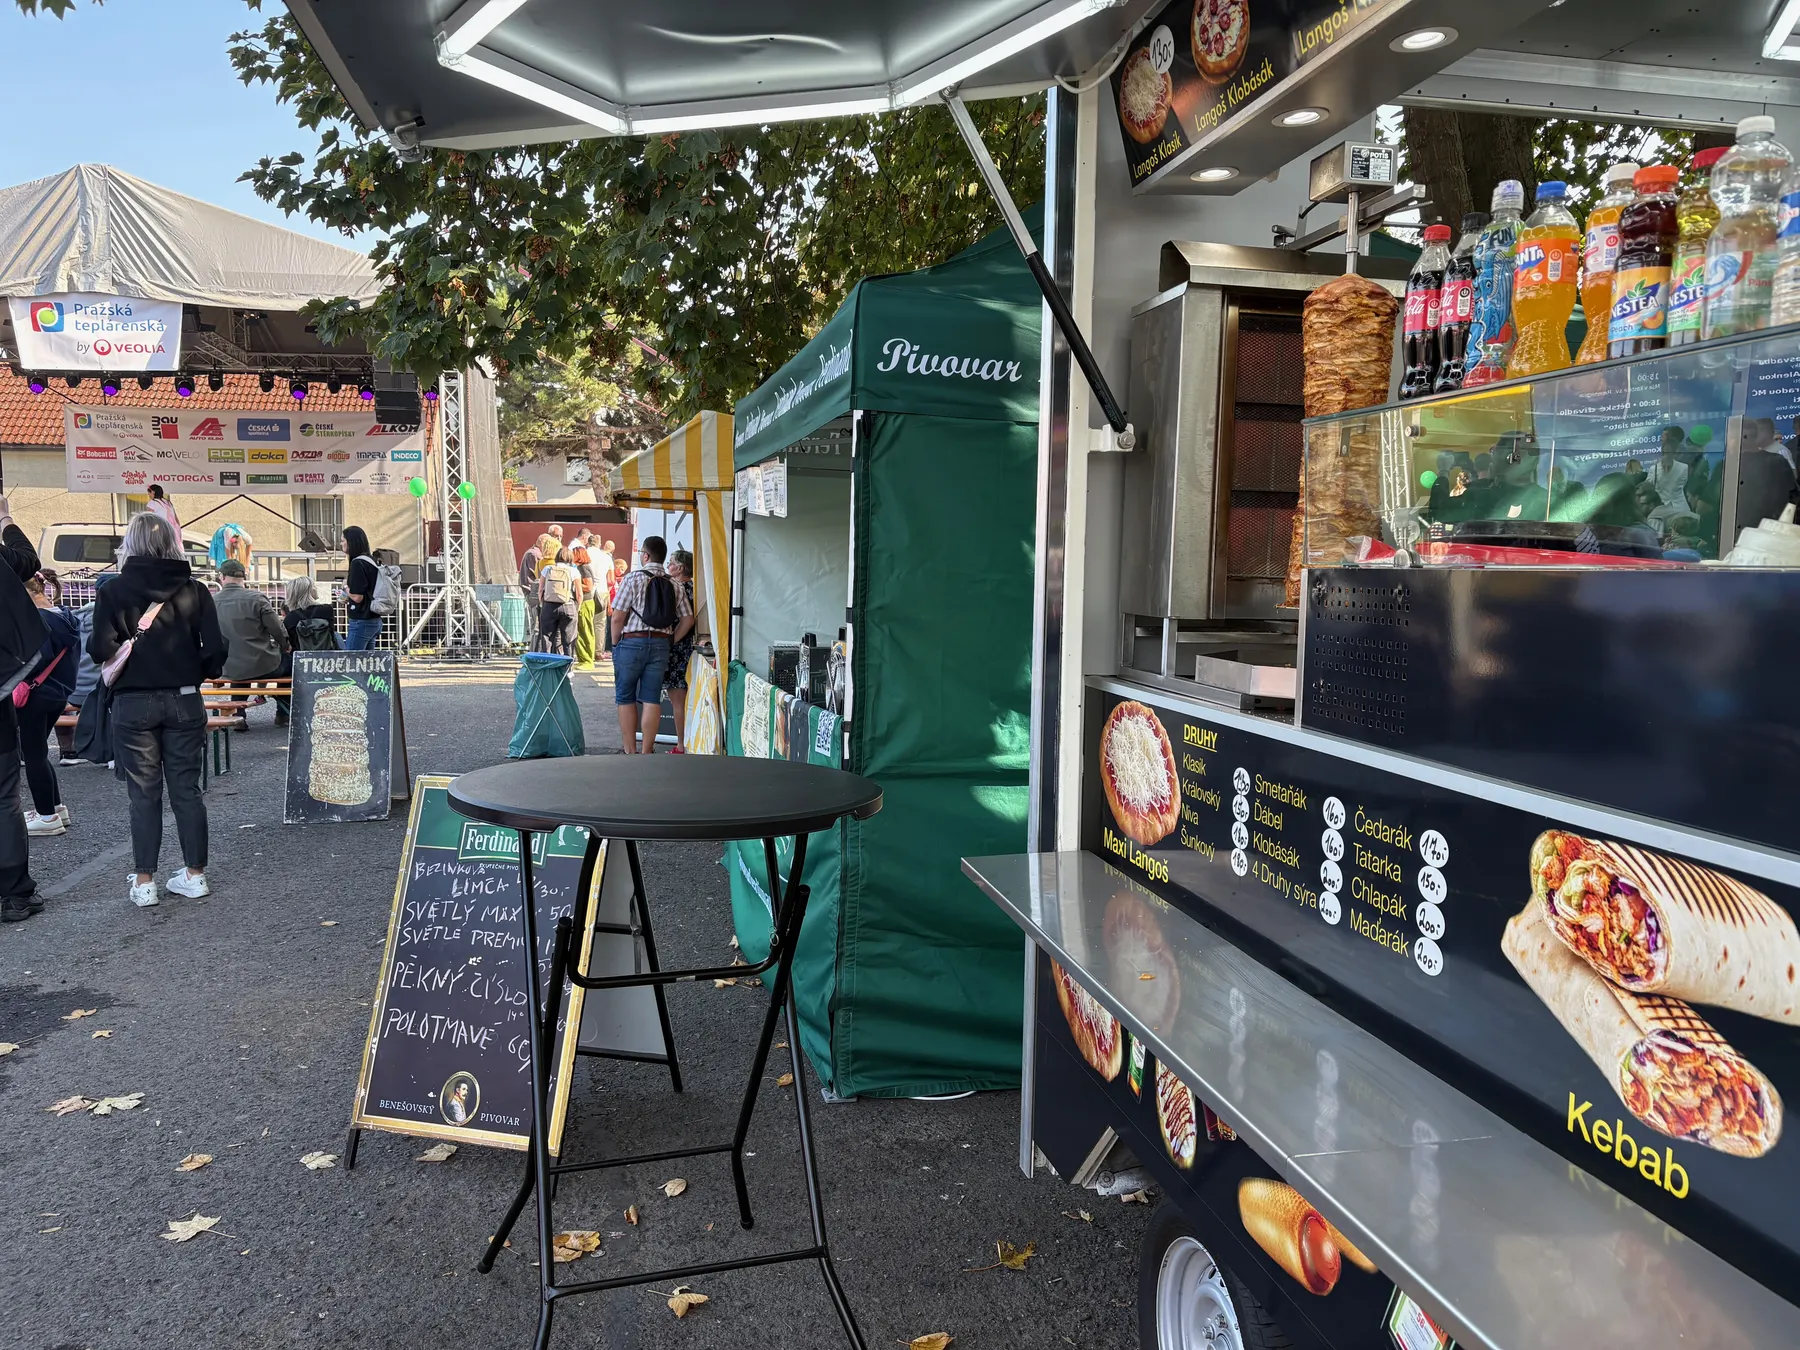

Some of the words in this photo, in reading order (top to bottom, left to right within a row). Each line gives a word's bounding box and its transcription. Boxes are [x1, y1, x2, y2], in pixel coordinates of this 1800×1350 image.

[1298, 0, 1349, 54] Langoš
[1195, 96, 1227, 132] Langoš
[1227, 58, 1275, 107] Klobásák
[1133, 148, 1159, 179] Langoš
[1158, 131, 1182, 161] Klasik
[1490, 227, 1512, 247] FUN
[74, 303, 132, 316] Pražská
[1668, 285, 1704, 308] NESTE
[75, 320, 164, 333] teplárenská
[1611, 323, 1633, 332] Peach
[76, 342, 90, 354] by
[114, 343, 166, 353] VEOLIA
[876, 338, 1022, 382] Pivovar
[96, 413, 126, 421] Pražská
[96, 421, 143, 430] teplárenská
[248, 423, 271, 431] ČESKÁ
[365, 425, 420, 436] ALKOM
[251, 452, 284, 460] doka
[153, 474, 214, 482] MOTORGAS
[1183, 723, 1218, 750] DRUHY
[1182, 752, 1207, 776] Klasik
[1182, 777, 1221, 811] Královský
[1254, 773, 1308, 811] Smetaňák
[1181, 802, 1199, 825] Niva
[1254, 798, 1283, 832] Ďábel
[465, 828, 541, 855] Ferdinad
[1354, 804, 1413, 852] Čedarák
[1103, 826, 1127, 859] Maxi
[1129, 840, 1169, 883] Langoš
[1180, 824, 1215, 863] Šunkový
[1253, 830, 1301, 870] Klobásák
[1353, 842, 1402, 883] Tatarka
[1252, 860, 1259, 879] 4
[1261, 863, 1292, 899] Druhy
[1294, 883, 1317, 909] sýra
[1351, 876, 1408, 921] Chlapák
[471, 930, 540, 950] PREMI
[1350, 908, 1410, 958] Maďarák
[379, 1099, 436, 1115] BENEŠOVSKÝ
[480, 1112, 521, 1127] PIVOVAR
[1566, 1091, 1690, 1200] Kebab
